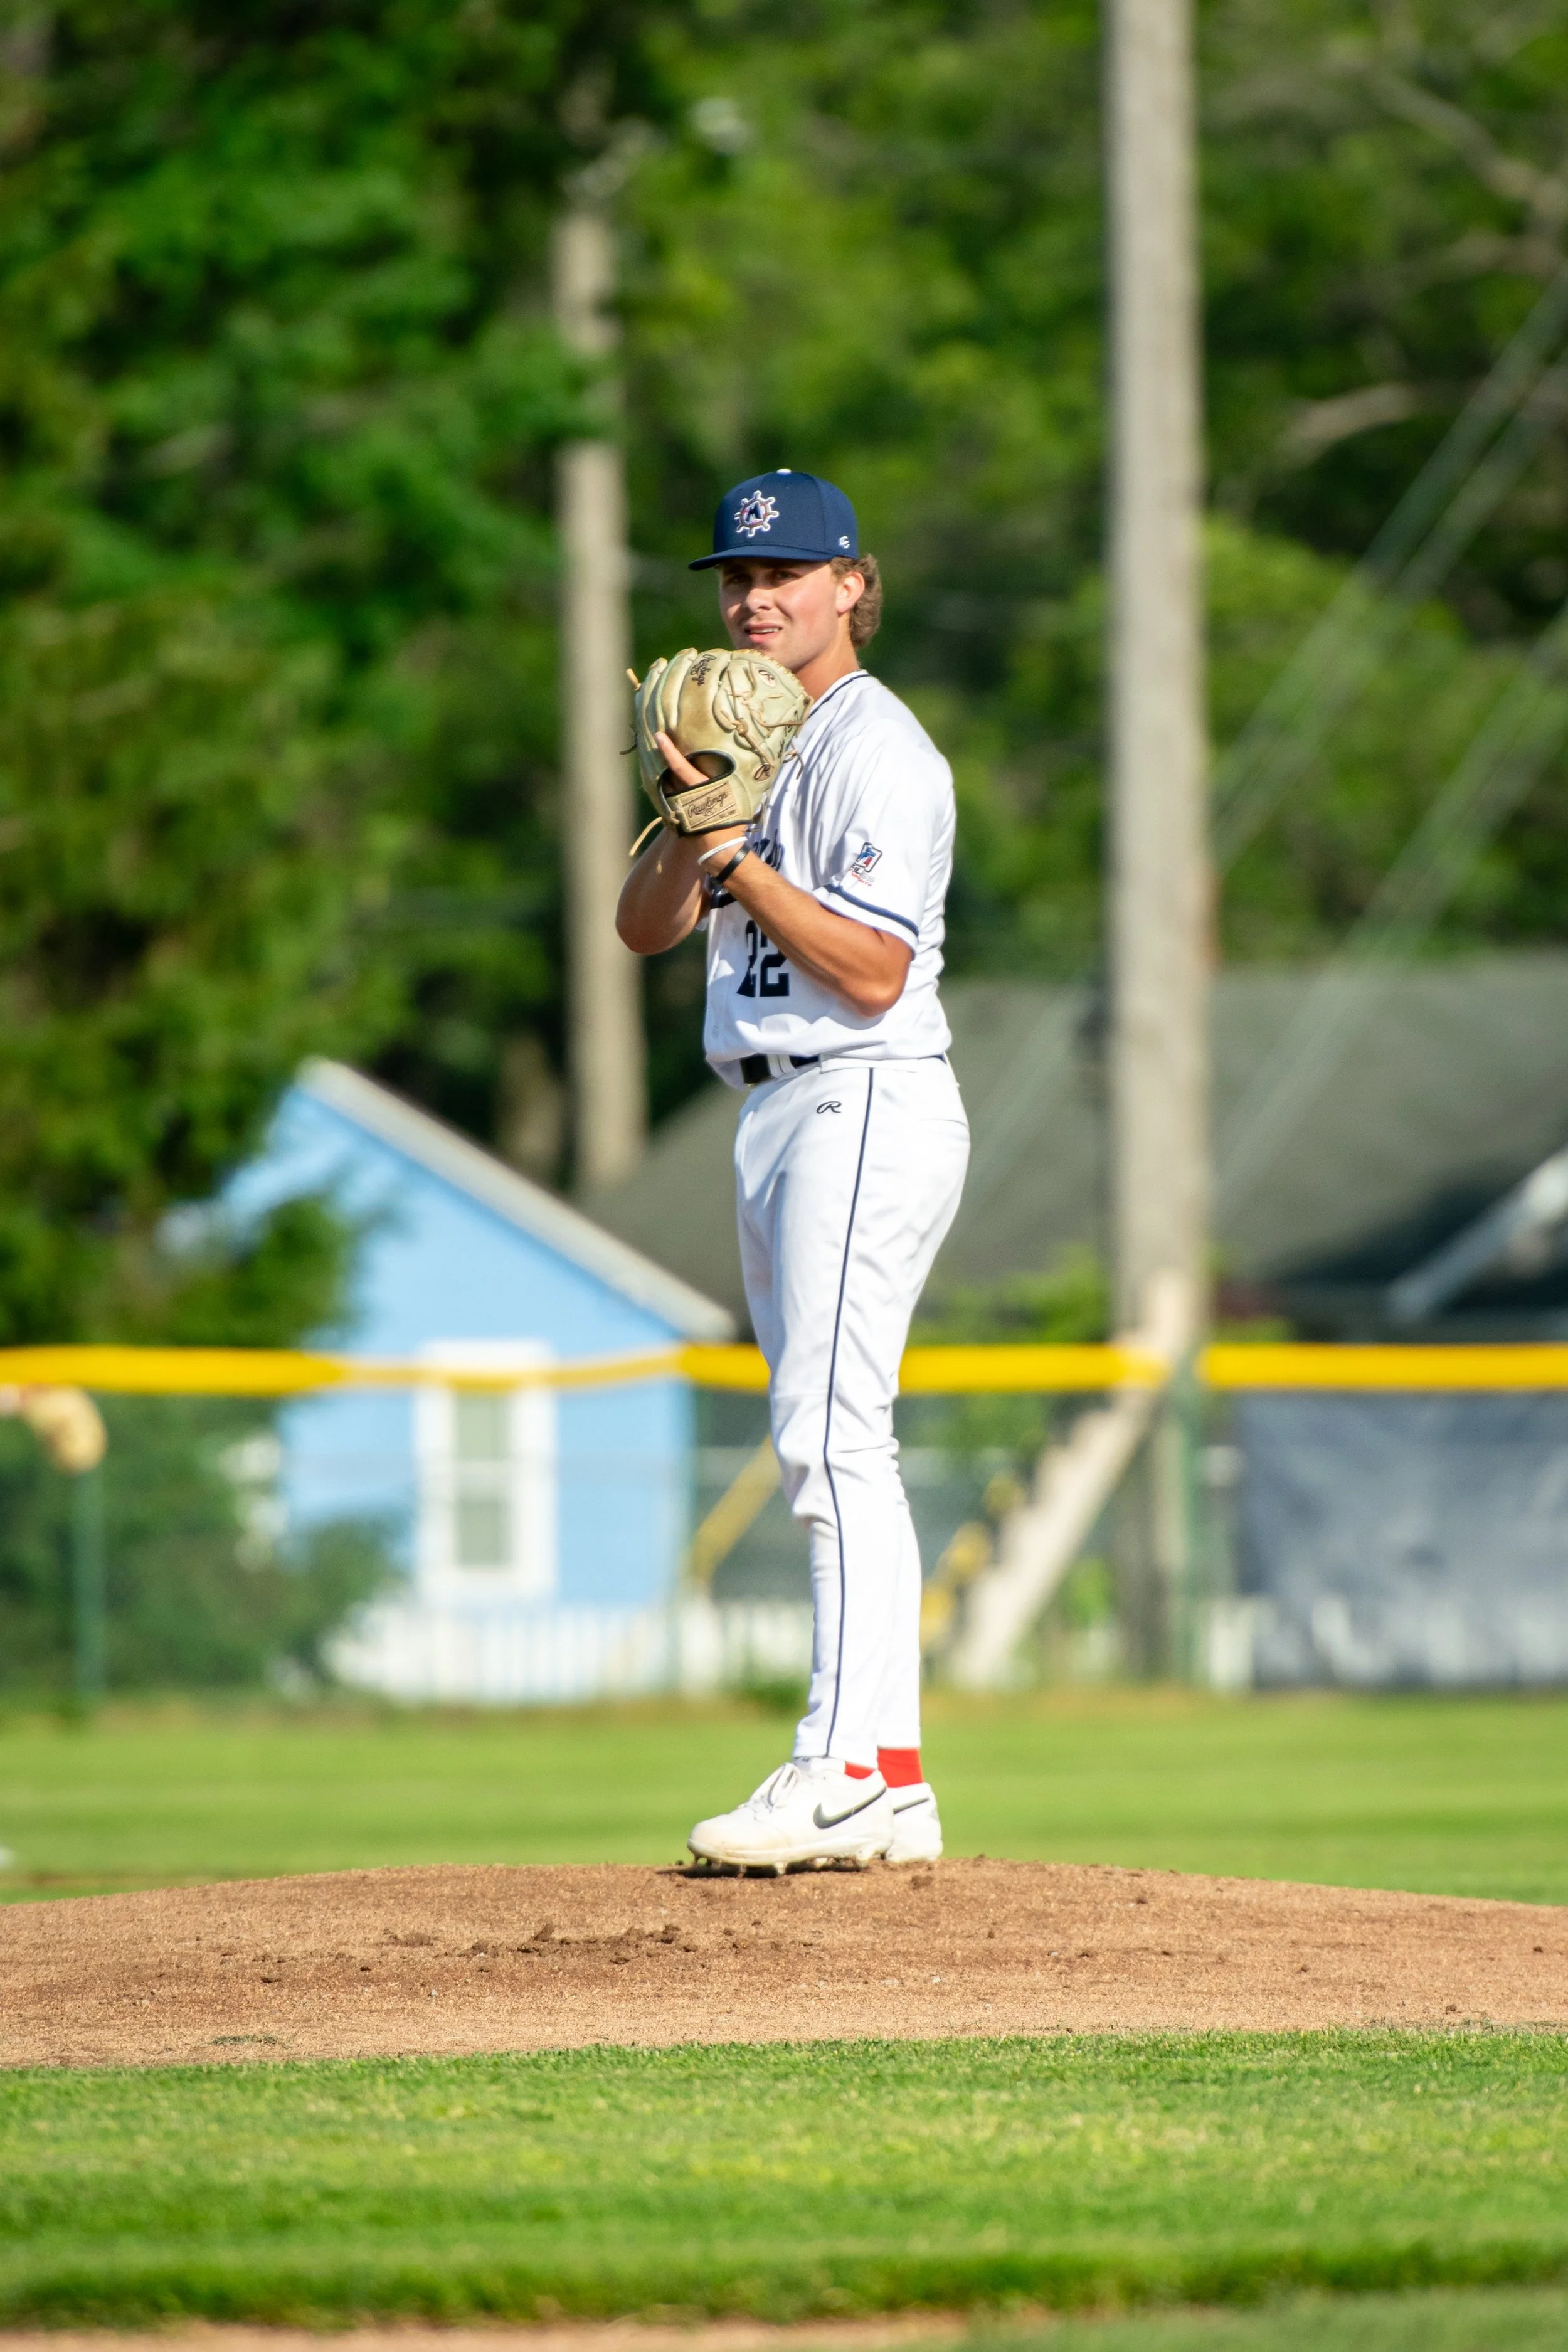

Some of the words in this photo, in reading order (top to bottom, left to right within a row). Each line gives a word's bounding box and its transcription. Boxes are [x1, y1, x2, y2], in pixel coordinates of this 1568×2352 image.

[688, 792, 728, 818] Rawlings
[736, 919, 790, 998] 22
[816, 1101, 842, 1114] R
